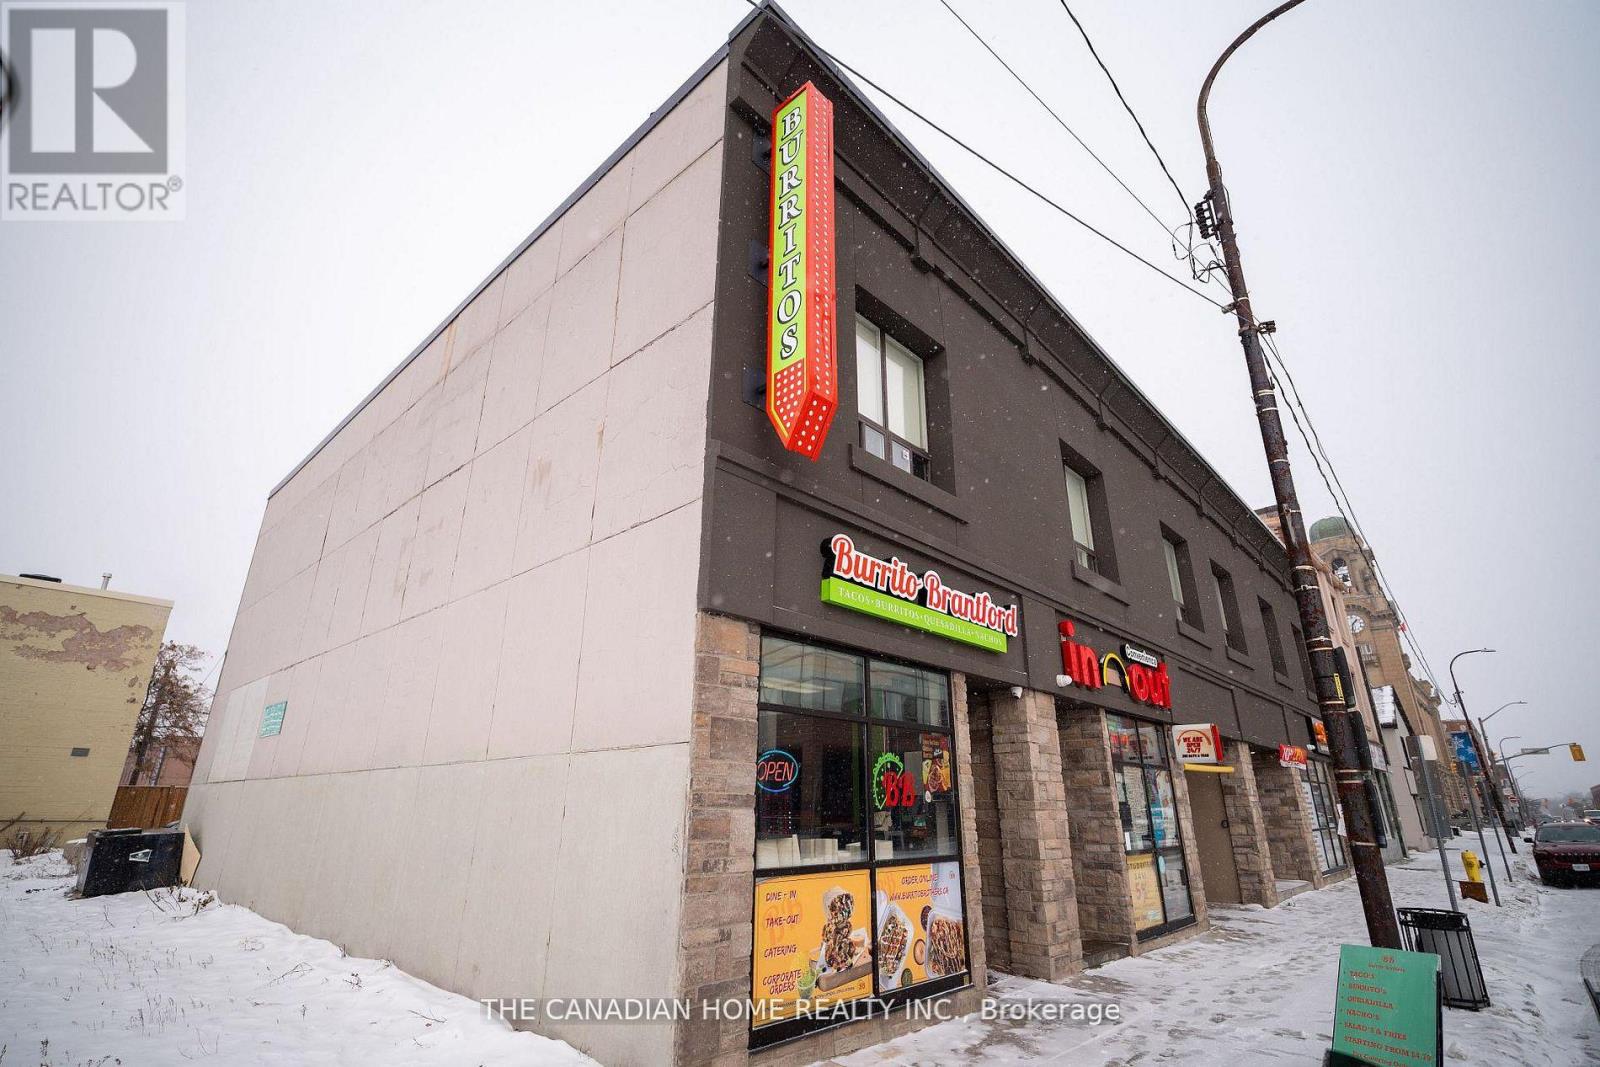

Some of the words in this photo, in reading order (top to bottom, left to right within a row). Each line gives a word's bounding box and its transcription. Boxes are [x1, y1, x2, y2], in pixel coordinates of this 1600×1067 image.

[778, 106, 803, 360] BURRITOS
[831, 533, 923, 601] Burrito
[924, 569, 1018, 637] Brantford
[838, 586, 871, 606] TACOS
[875, 597, 920, 620] BURRITOS
[757, 761, 793, 782] OPEN
[765, 892, 783, 902] DINE
[789, 890, 797, 899] IN
[765, 914, 800, 928] TAKE-OUT
[764, 945, 797, 958] CATERING
[762, 969, 802, 986] CORPORATE
[769, 981, 796, 995] ORDERS
